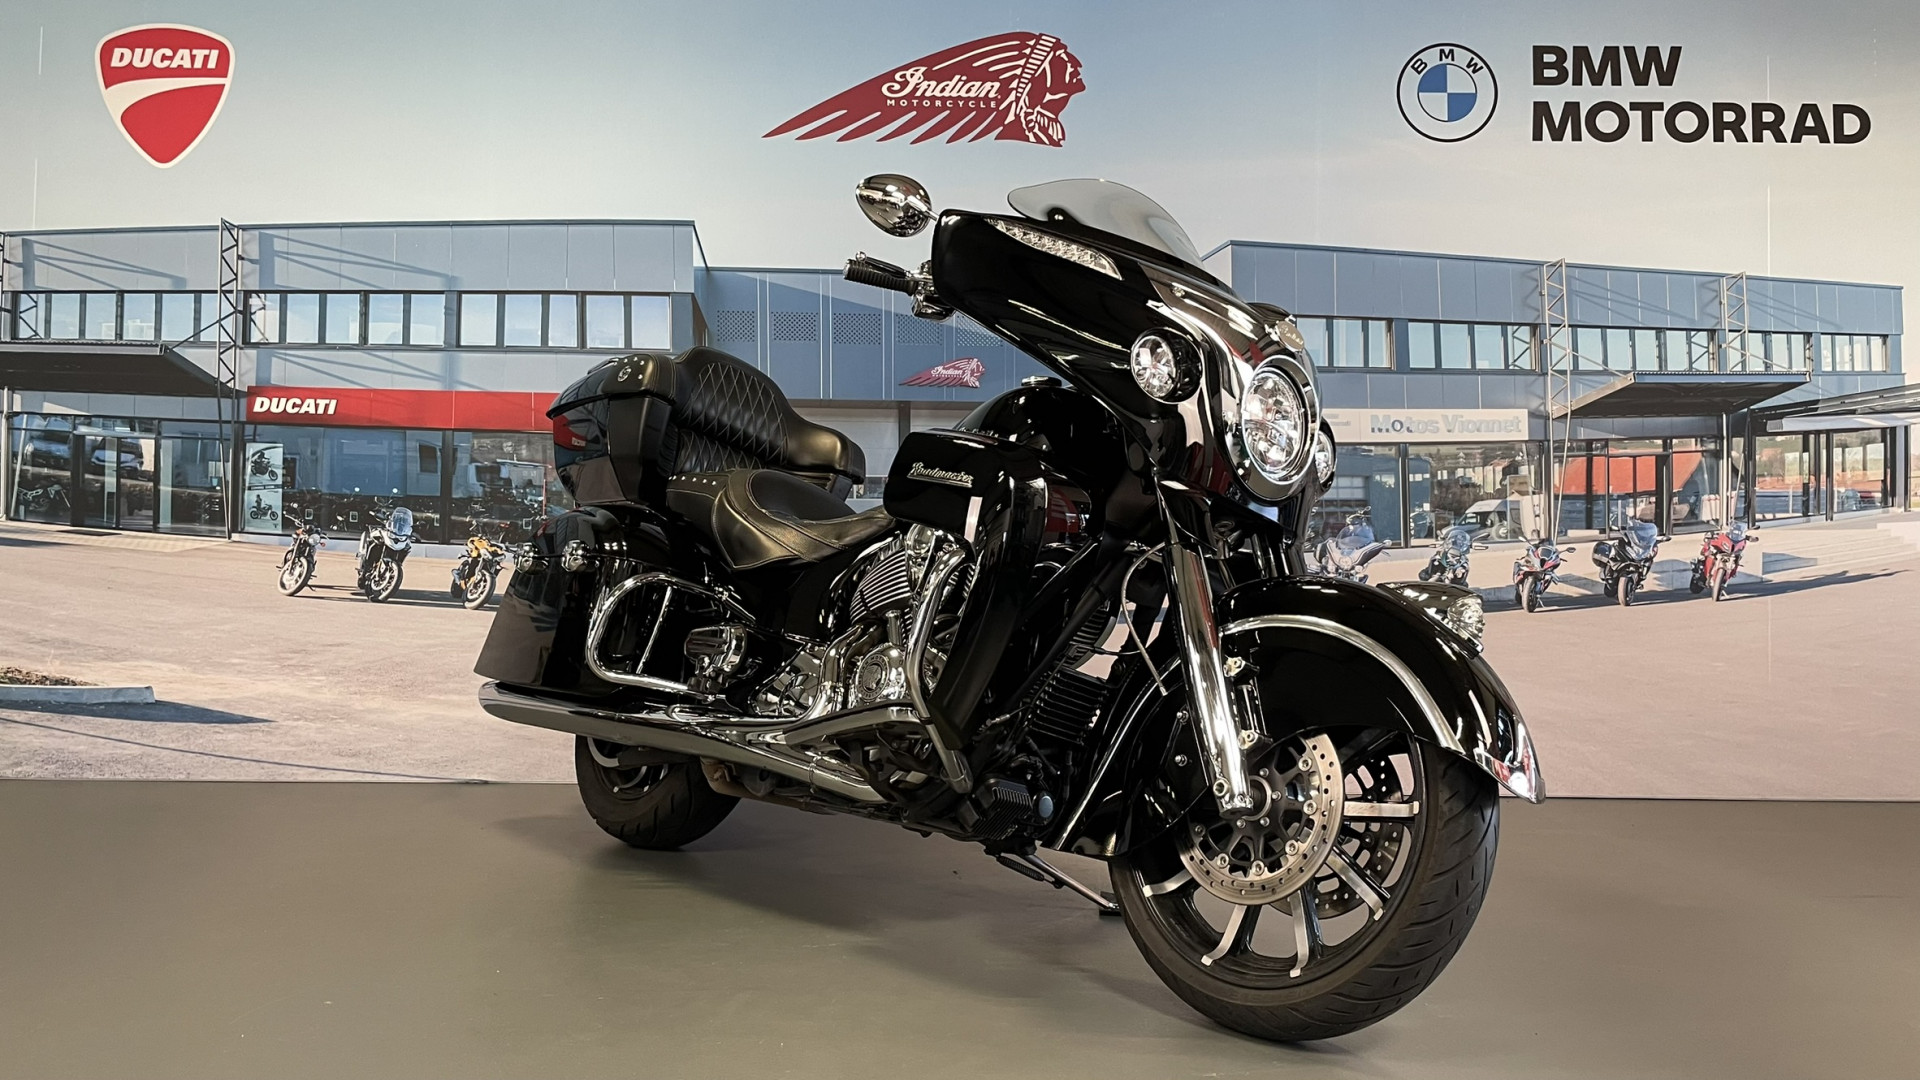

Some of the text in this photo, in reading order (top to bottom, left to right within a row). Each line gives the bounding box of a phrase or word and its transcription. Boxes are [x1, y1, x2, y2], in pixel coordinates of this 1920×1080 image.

[110, 47, 219, 69] DUCATI
[1410, 48, 1484, 75] BMW
[1532, 45, 1683, 87] BMW
[881, 66, 1001, 98] Indian
[886, 99, 997, 108] MOTORCYCLE
[1532, 101, 1872, 144] MOTORRAD
[931, 366, 963, 375] Indian
[253, 396, 338, 415] DUCATI
[1370, 414, 1440, 434] Motos
[1441, 413, 1521, 434] Vionnet
